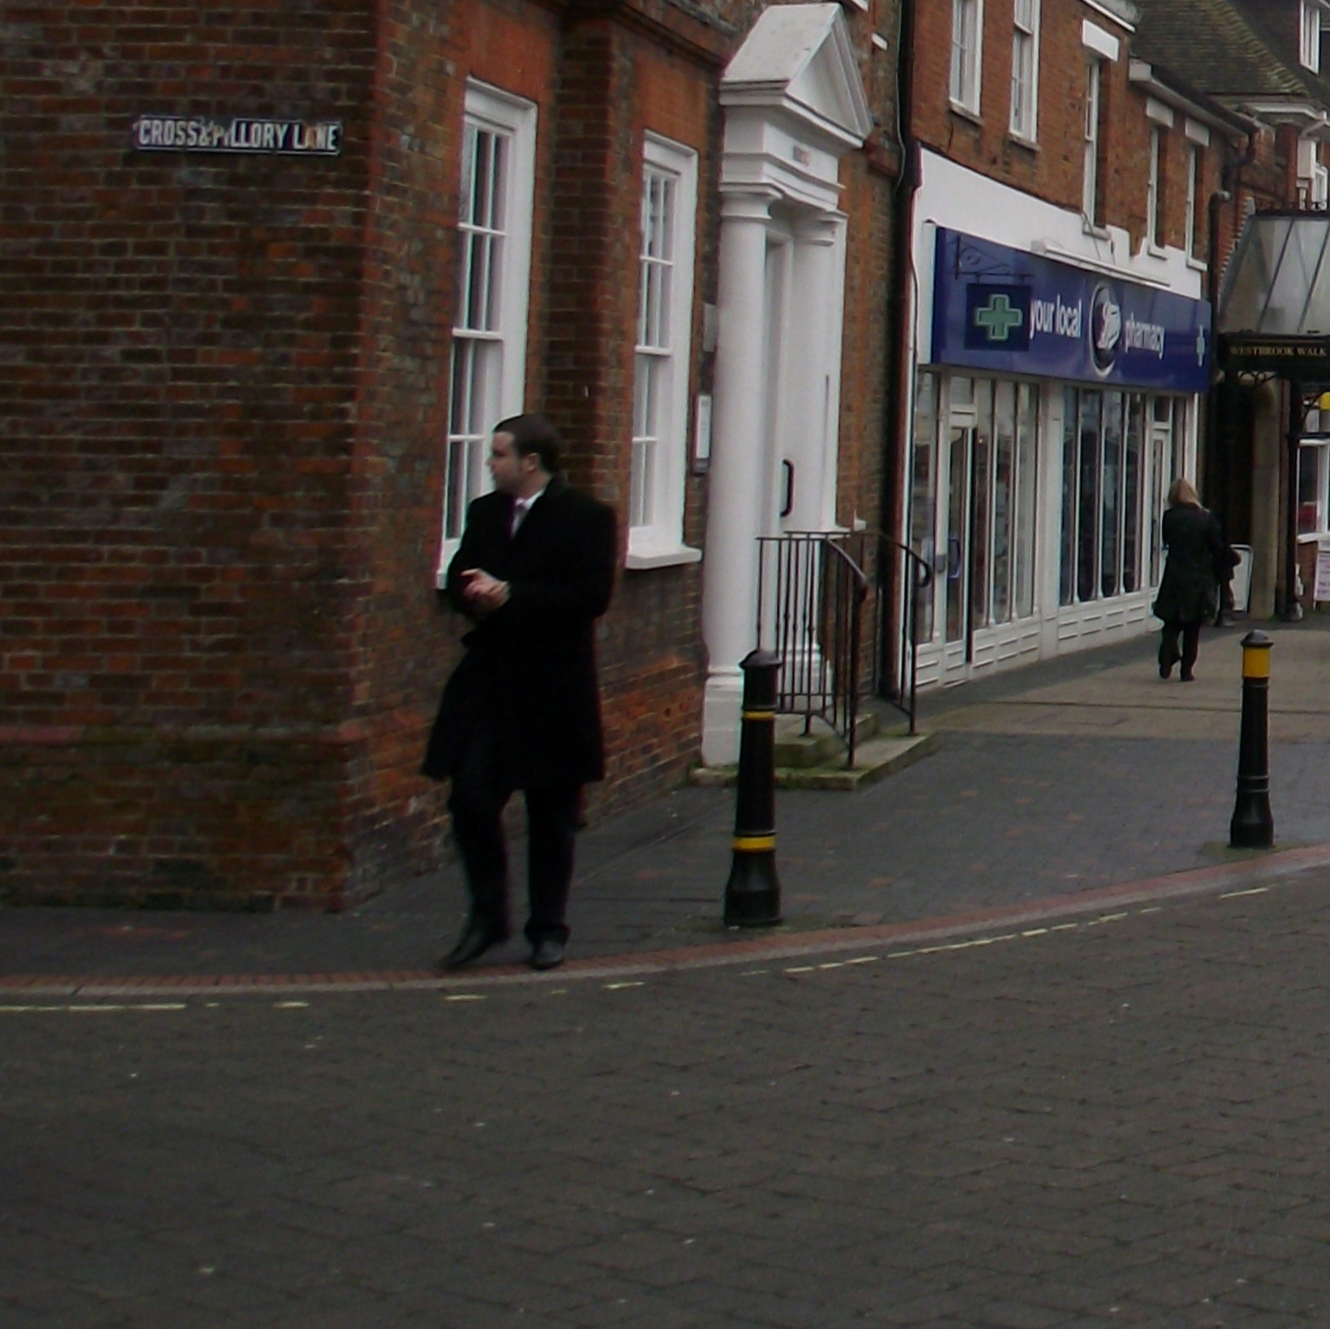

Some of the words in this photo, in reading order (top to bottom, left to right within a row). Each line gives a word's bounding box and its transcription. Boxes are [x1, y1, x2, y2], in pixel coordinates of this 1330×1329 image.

[139, 120, 198, 145] CROSS
[293, 123, 338, 150] LANE
[1029, 296, 1055, 339] your
[1056, 299, 1082, 338] local
[1125, 312, 1165, 360] pharmacy
[1230, 345, 1295, 357] WESTBROOK
[1297, 346, 1327, 357] WALK
